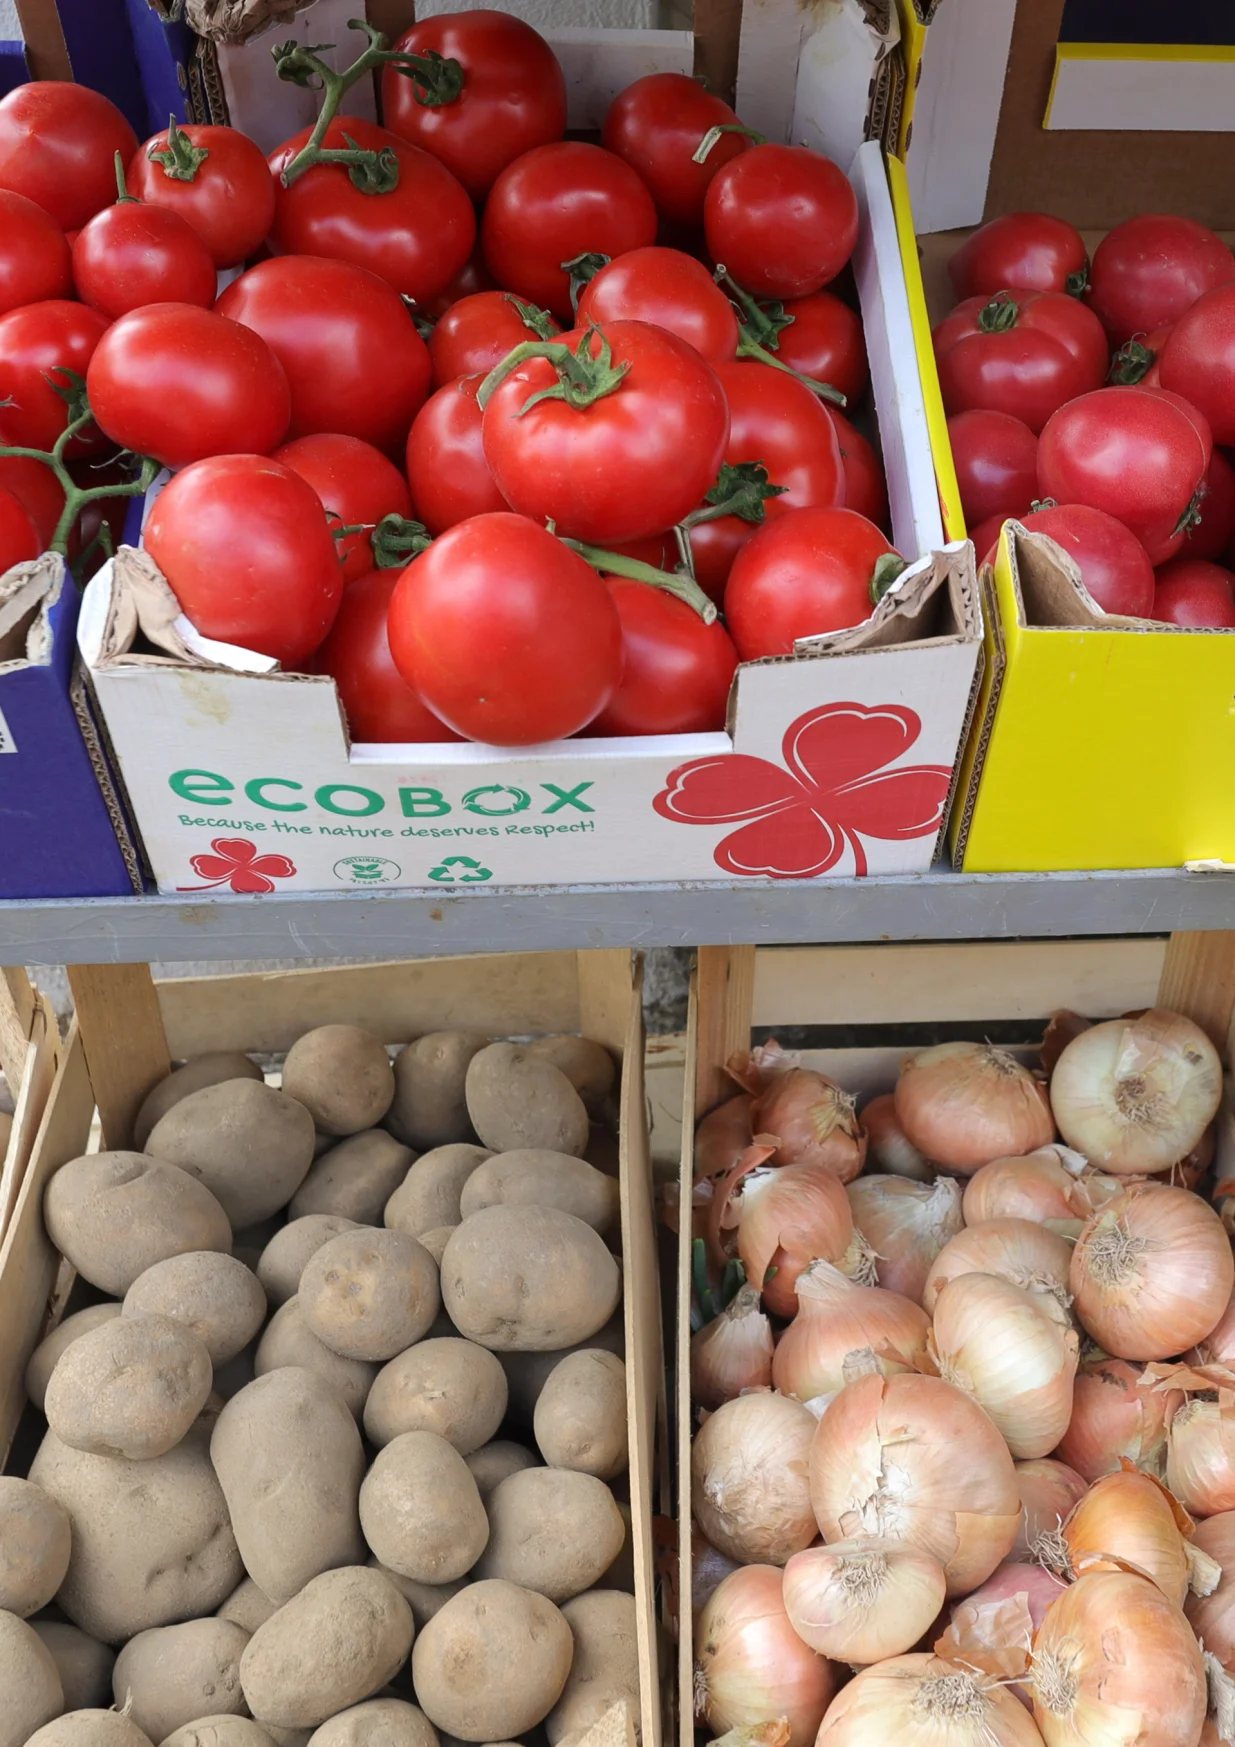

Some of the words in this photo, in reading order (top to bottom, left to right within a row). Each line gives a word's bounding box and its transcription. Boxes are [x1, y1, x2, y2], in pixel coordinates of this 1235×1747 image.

[178, 814, 267, 831] Because
[271, 820, 313, 834] the
[319, 825, 394, 838] nature
[400, 826, 500, 838] deserves
[505, 820, 595, 838] Respect!
